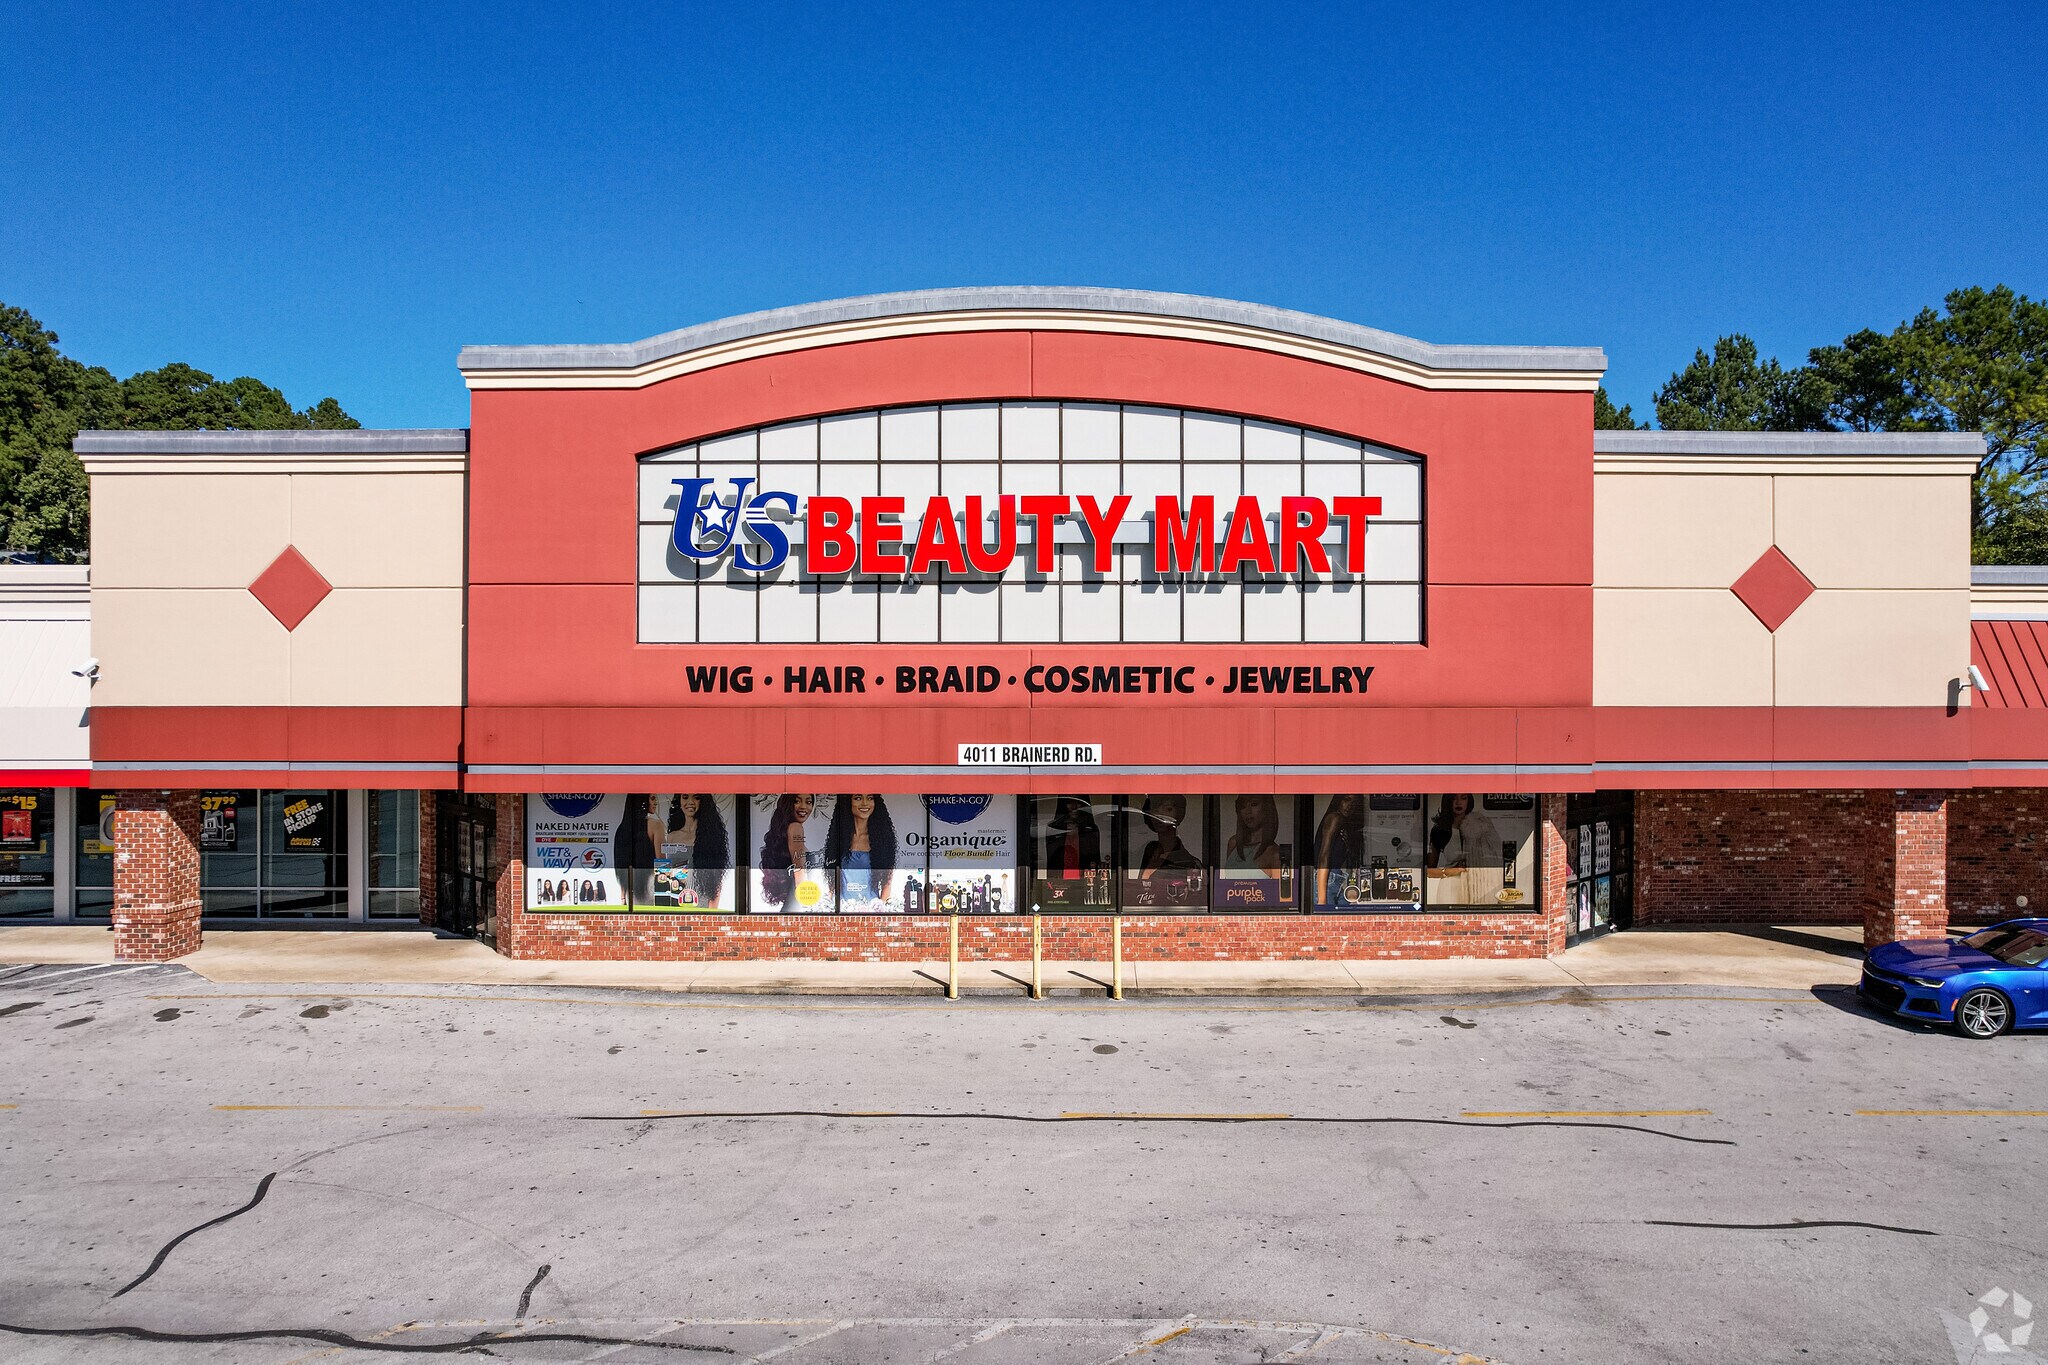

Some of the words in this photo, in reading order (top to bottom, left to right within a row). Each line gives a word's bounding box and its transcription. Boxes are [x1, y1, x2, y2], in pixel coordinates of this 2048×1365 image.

[671, 477, 798, 572] US
[806, 495, 1132, 574] BEAUTY
[1155, 495, 1383, 574] MART
[686, 666, 754, 693] WIG
[784, 666, 866, 693] HAIR
[896, 666, 1001, 693] BRAID
[1024, 665, 1195, 694] COSMETIC
[1223, 666, 1375, 693] JEWELRY
[963, 746, 997, 763] 4011
[1003, 746, 1070, 763] BRAINERD
[1075, 746, 1097, 763] RD.
[12, 795, 38, 810] $15
[284, 799, 310, 817] FREE
[929, 796, 984, 805] SHAKE-N-GO
[284, 816, 295, 827] IN
[295, 802, 324, 821] STORE
[286, 814, 317, 835] PICKUP
[536, 822, 570, 831] NAKED
[573, 822, 609, 831] NATURE
[906, 831, 1003, 850] Organique
[543, 856, 579, 875] WAVY
[0, 874, 21, 883] FREE
[1227, 886, 1263, 901] purple
[1246, 893, 1266, 905] pack
